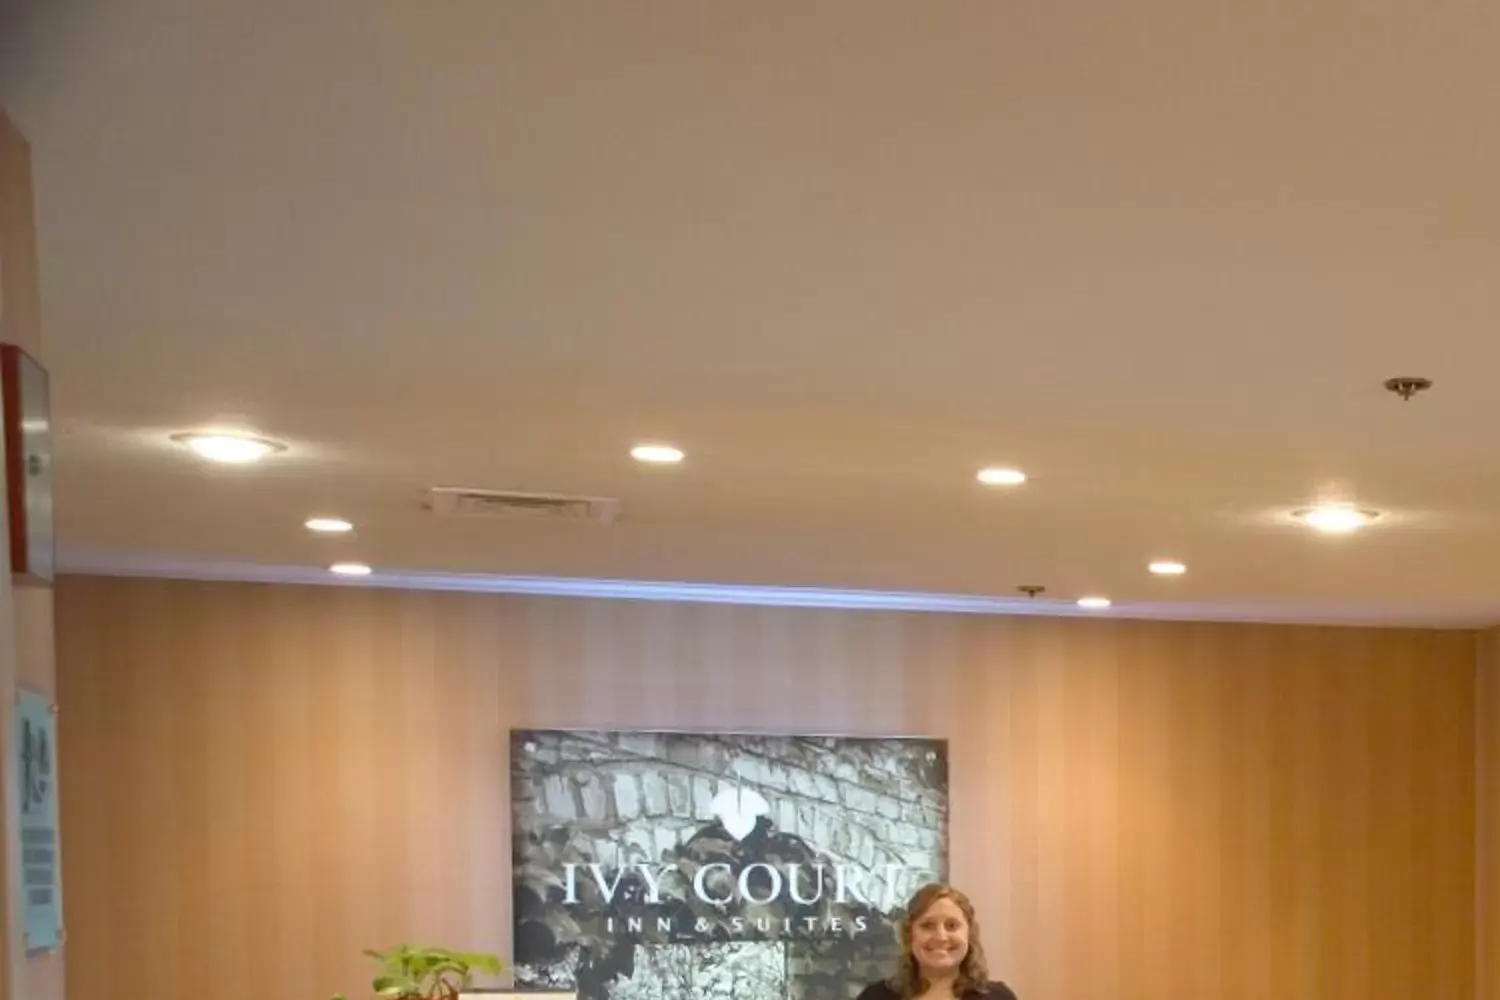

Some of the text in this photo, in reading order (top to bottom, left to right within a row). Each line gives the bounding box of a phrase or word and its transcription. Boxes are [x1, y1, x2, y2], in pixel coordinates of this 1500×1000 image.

[561, 862, 908, 905] IVY COURT
[606, 915, 867, 933] INN & SUITES
